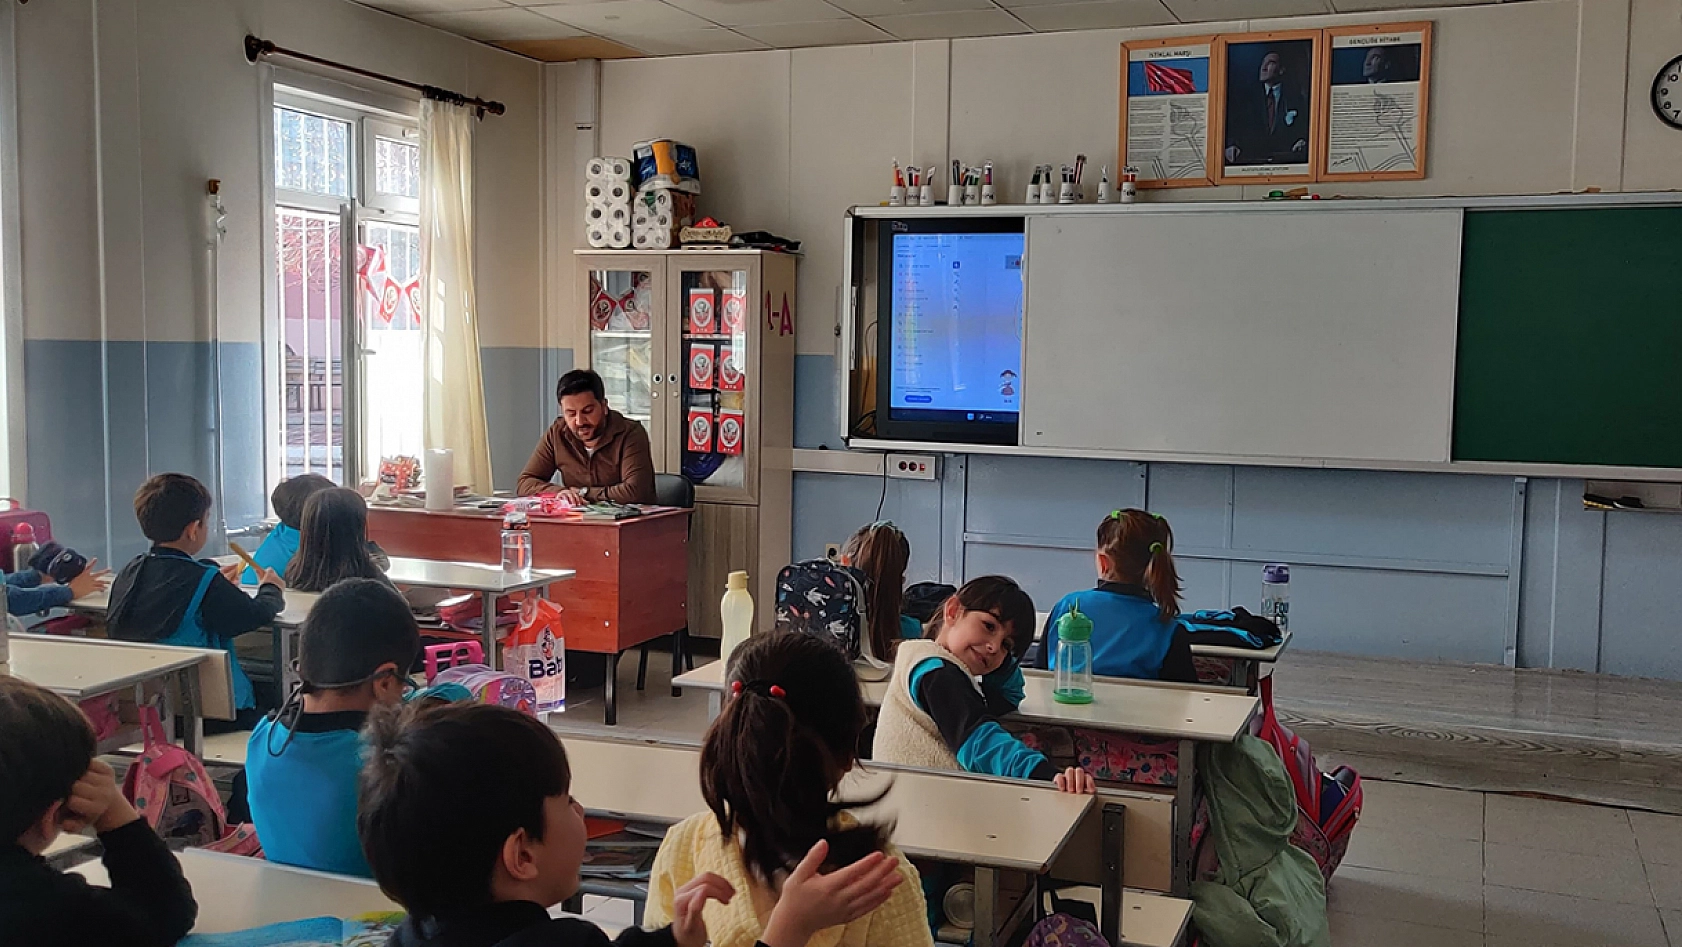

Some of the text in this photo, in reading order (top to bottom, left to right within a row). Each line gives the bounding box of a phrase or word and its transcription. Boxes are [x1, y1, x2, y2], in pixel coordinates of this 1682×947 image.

[1667, 74, 1679, 82] 10
[1673, 110, 1681, 119] 7
[765, 290, 793, 336] 1-A
